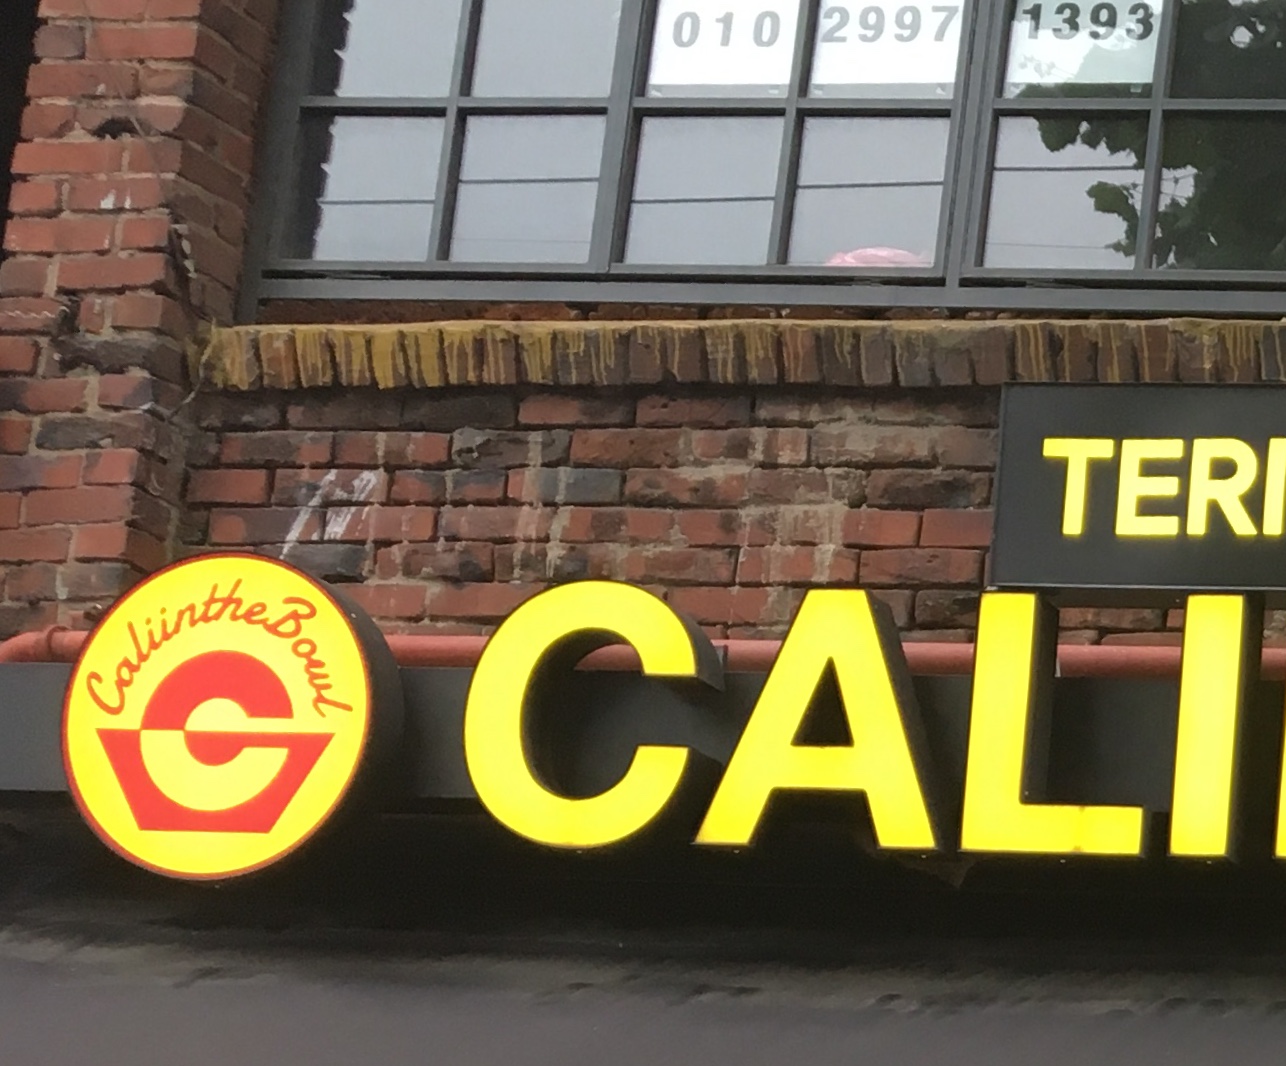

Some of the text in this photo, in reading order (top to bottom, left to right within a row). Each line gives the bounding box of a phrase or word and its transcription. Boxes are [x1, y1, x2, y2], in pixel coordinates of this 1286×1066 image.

[671, 1, 1154, 50] 010 2997 1393
